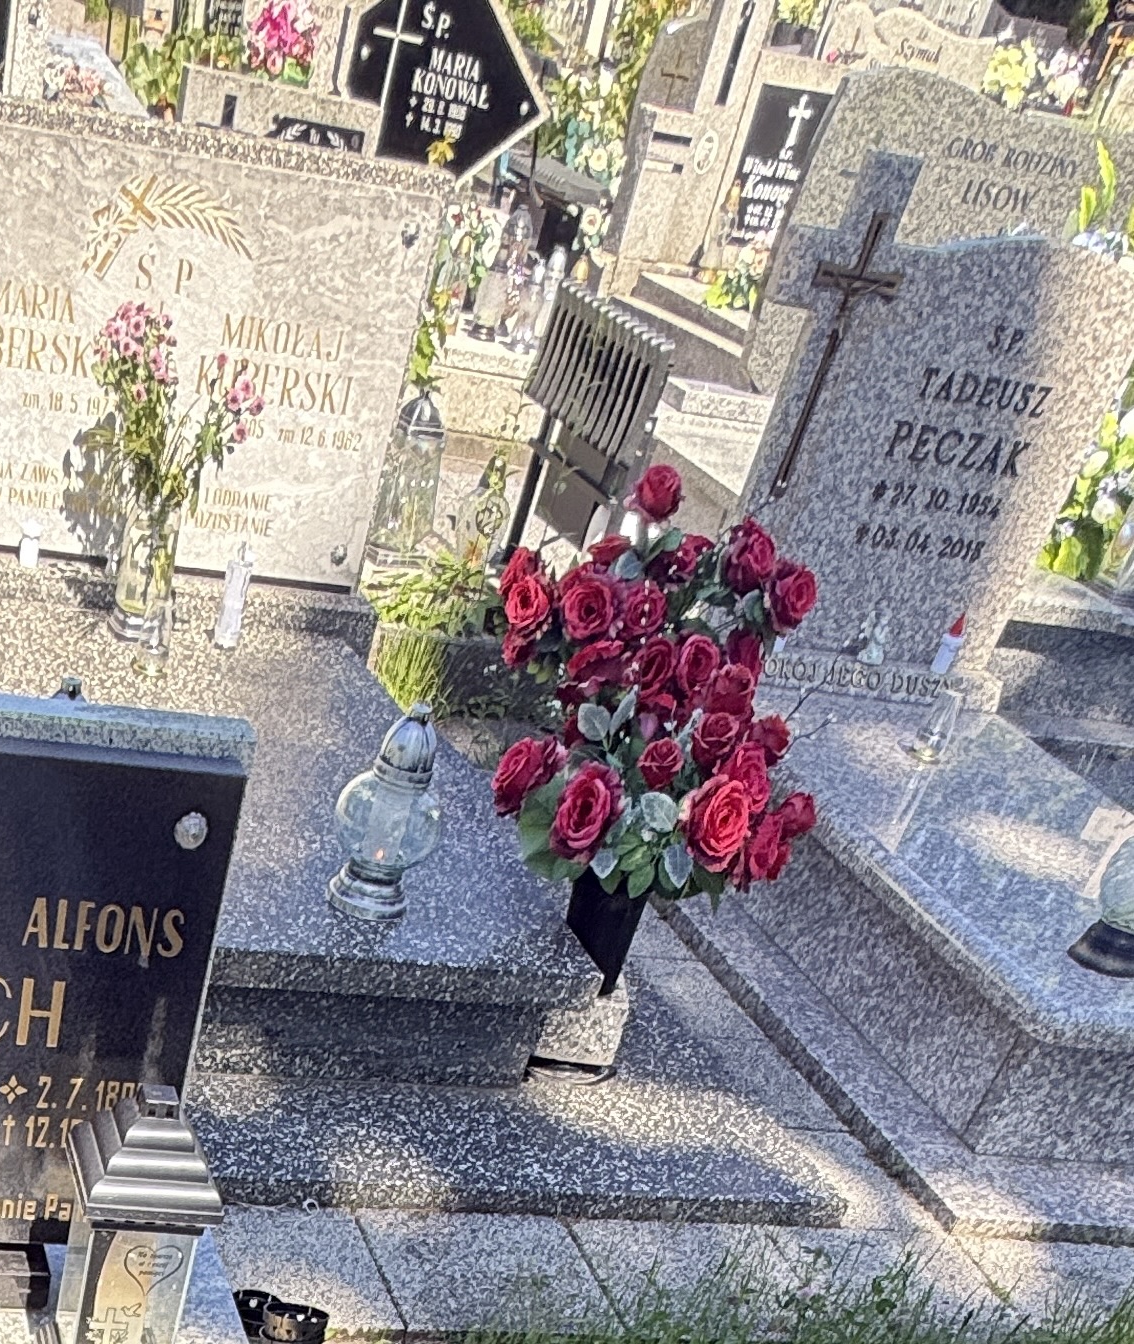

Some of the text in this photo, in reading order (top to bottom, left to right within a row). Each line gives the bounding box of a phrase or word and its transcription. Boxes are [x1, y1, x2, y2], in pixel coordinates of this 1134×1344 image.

[411, 67, 490, 110] KONOWAŁ
[428, 46, 480, 82] MARIA
[219, 312, 347, 362] MIKOŁAJ
[919, 367, 1053, 418] TADEUSZ
[22, 896, 186, 958] ALFONS
